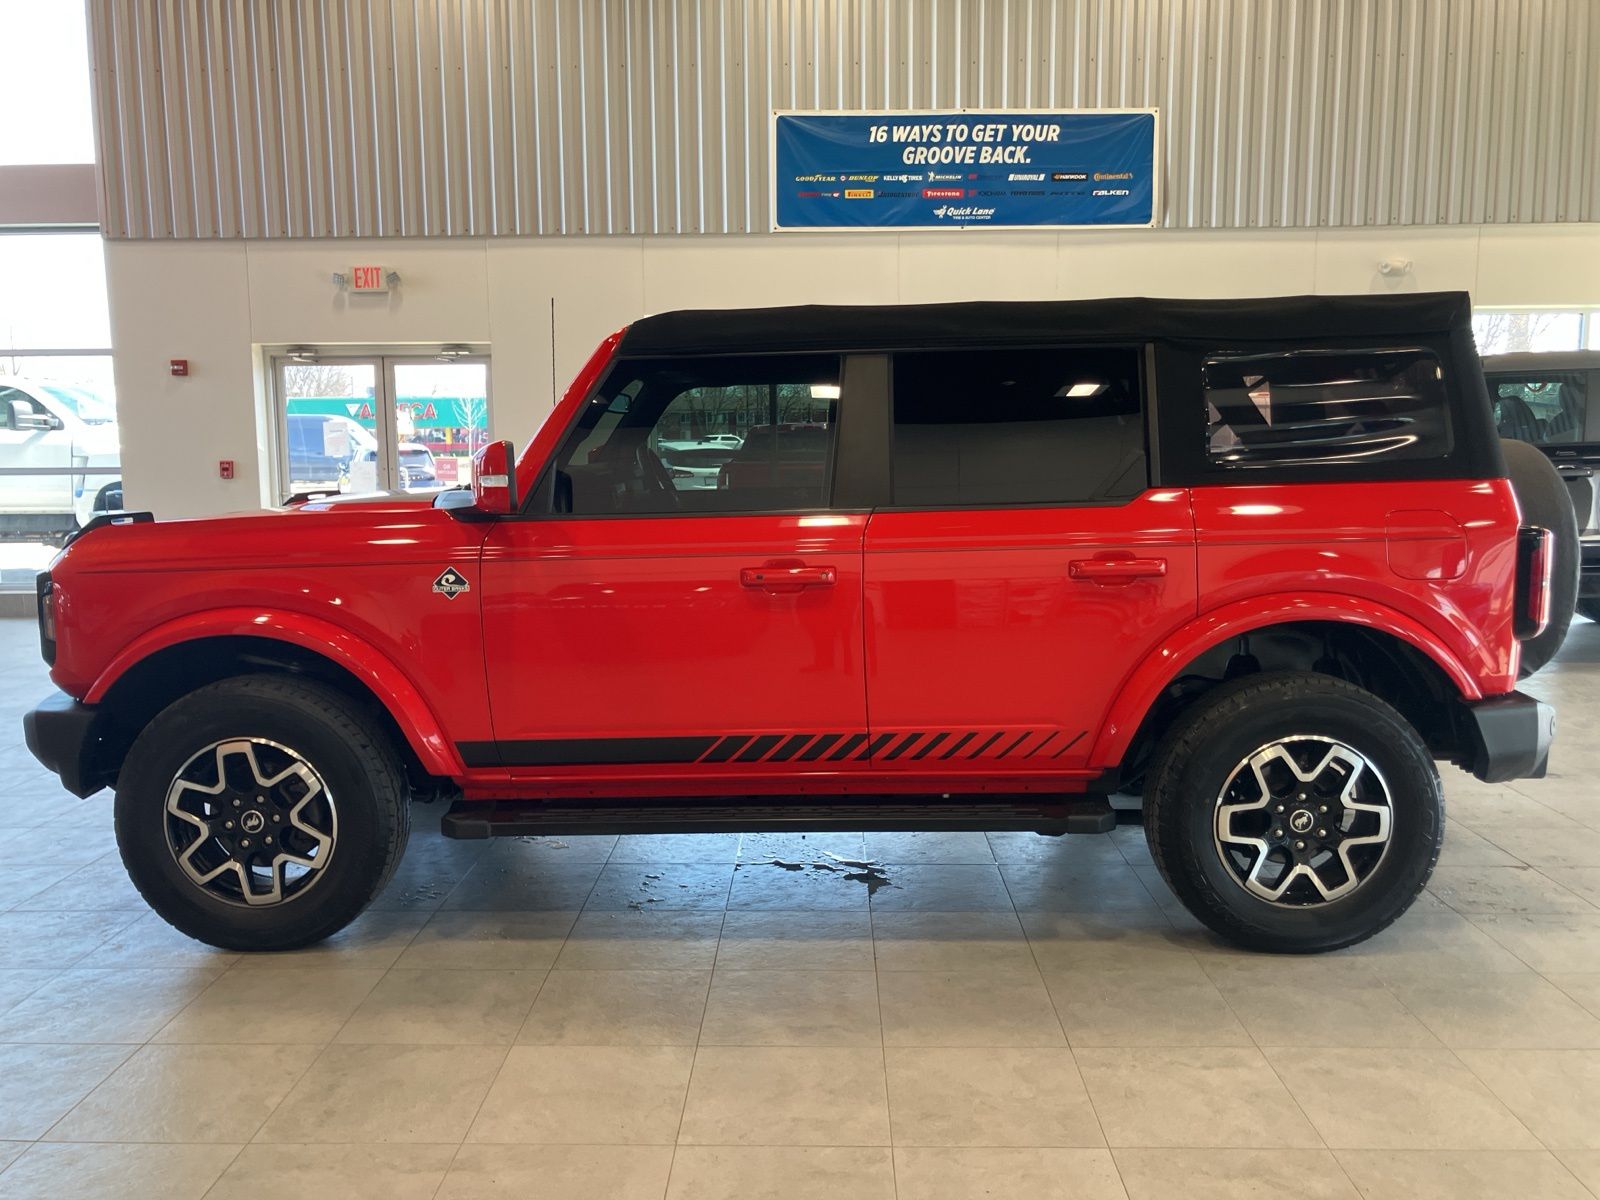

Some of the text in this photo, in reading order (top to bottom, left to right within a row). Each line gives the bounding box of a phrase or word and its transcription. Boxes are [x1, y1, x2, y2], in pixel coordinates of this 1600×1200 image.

[869, 124, 1061, 143] 16 WAYS TO GET YOUR
[902, 146, 1031, 165] GROOVE BACK.
[795, 174, 836, 183] GOODYEAR
[848, 175, 879, 183] DUNLOP
[1093, 173, 1129, 182] Continental
[927, 190, 960, 198] Firestone
[946, 206, 994, 216] Quick Lane
[354, 267, 381, 288] EXIT
